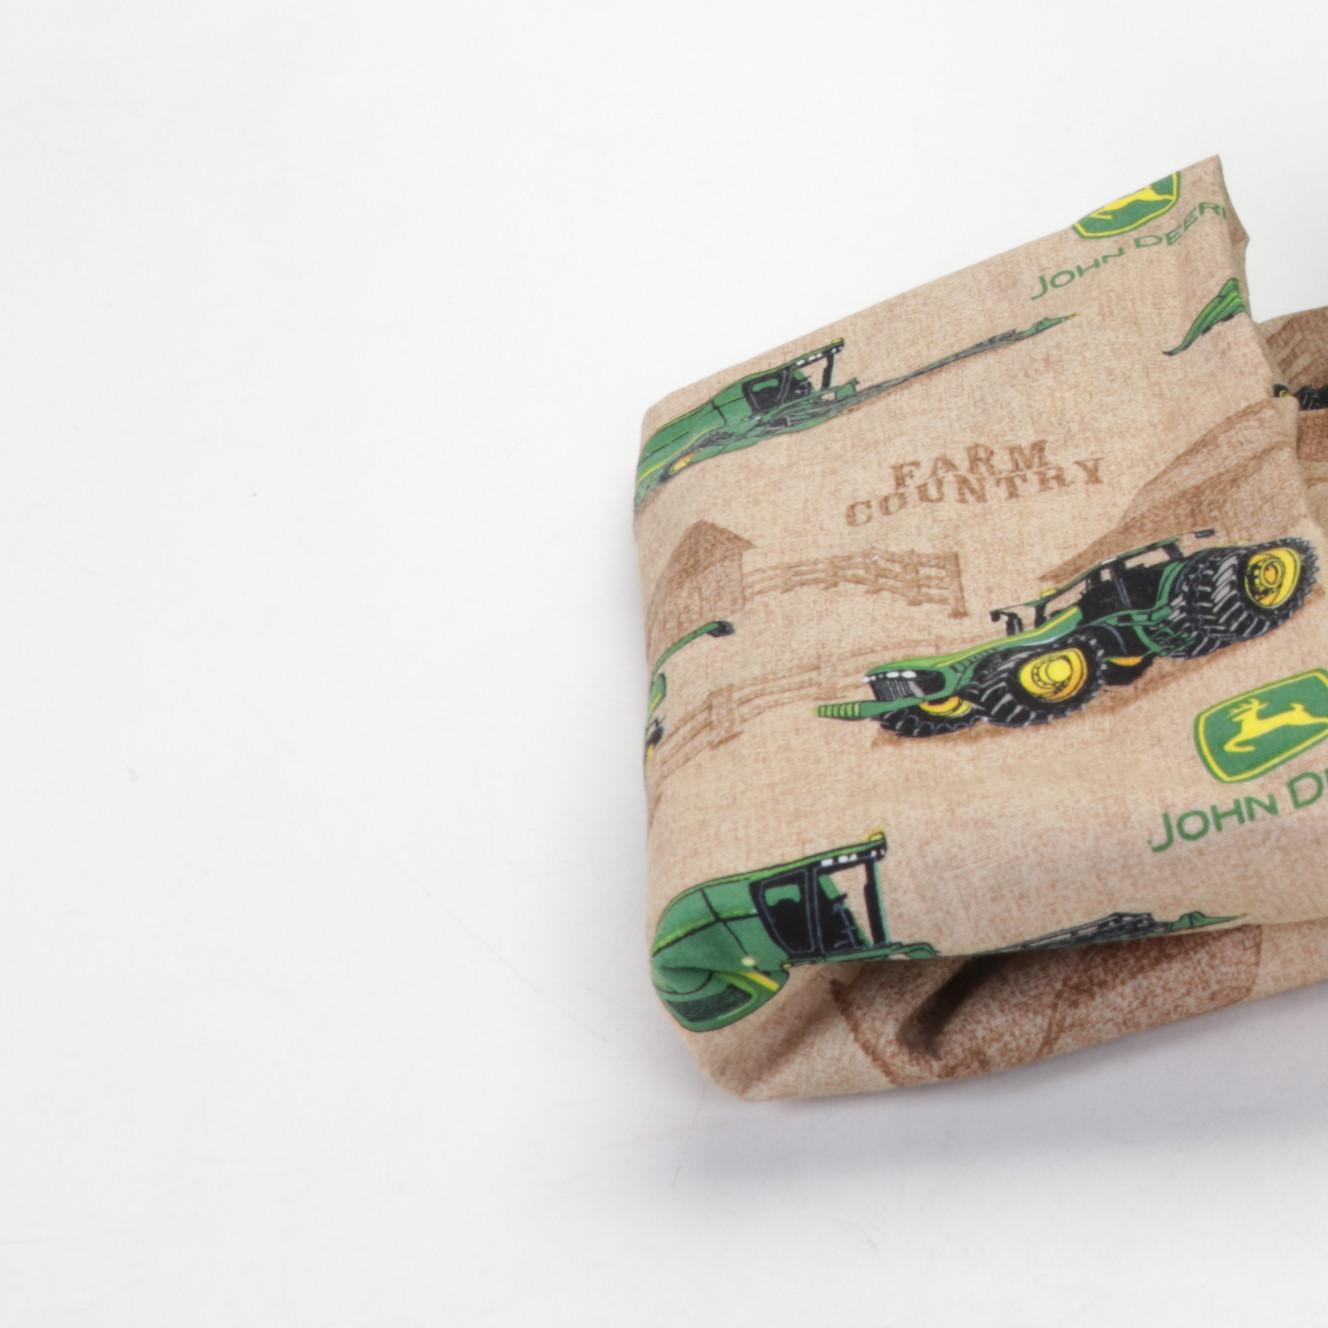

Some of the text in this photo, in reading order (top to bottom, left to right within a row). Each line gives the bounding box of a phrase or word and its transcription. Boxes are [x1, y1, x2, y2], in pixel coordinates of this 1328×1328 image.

[1030, 247, 1125, 300] JOHN
[845, 457, 1104, 527] COUNTRY
[890, 440, 1048, 490] FARM
[1148, 794, 1279, 853] JOHN
